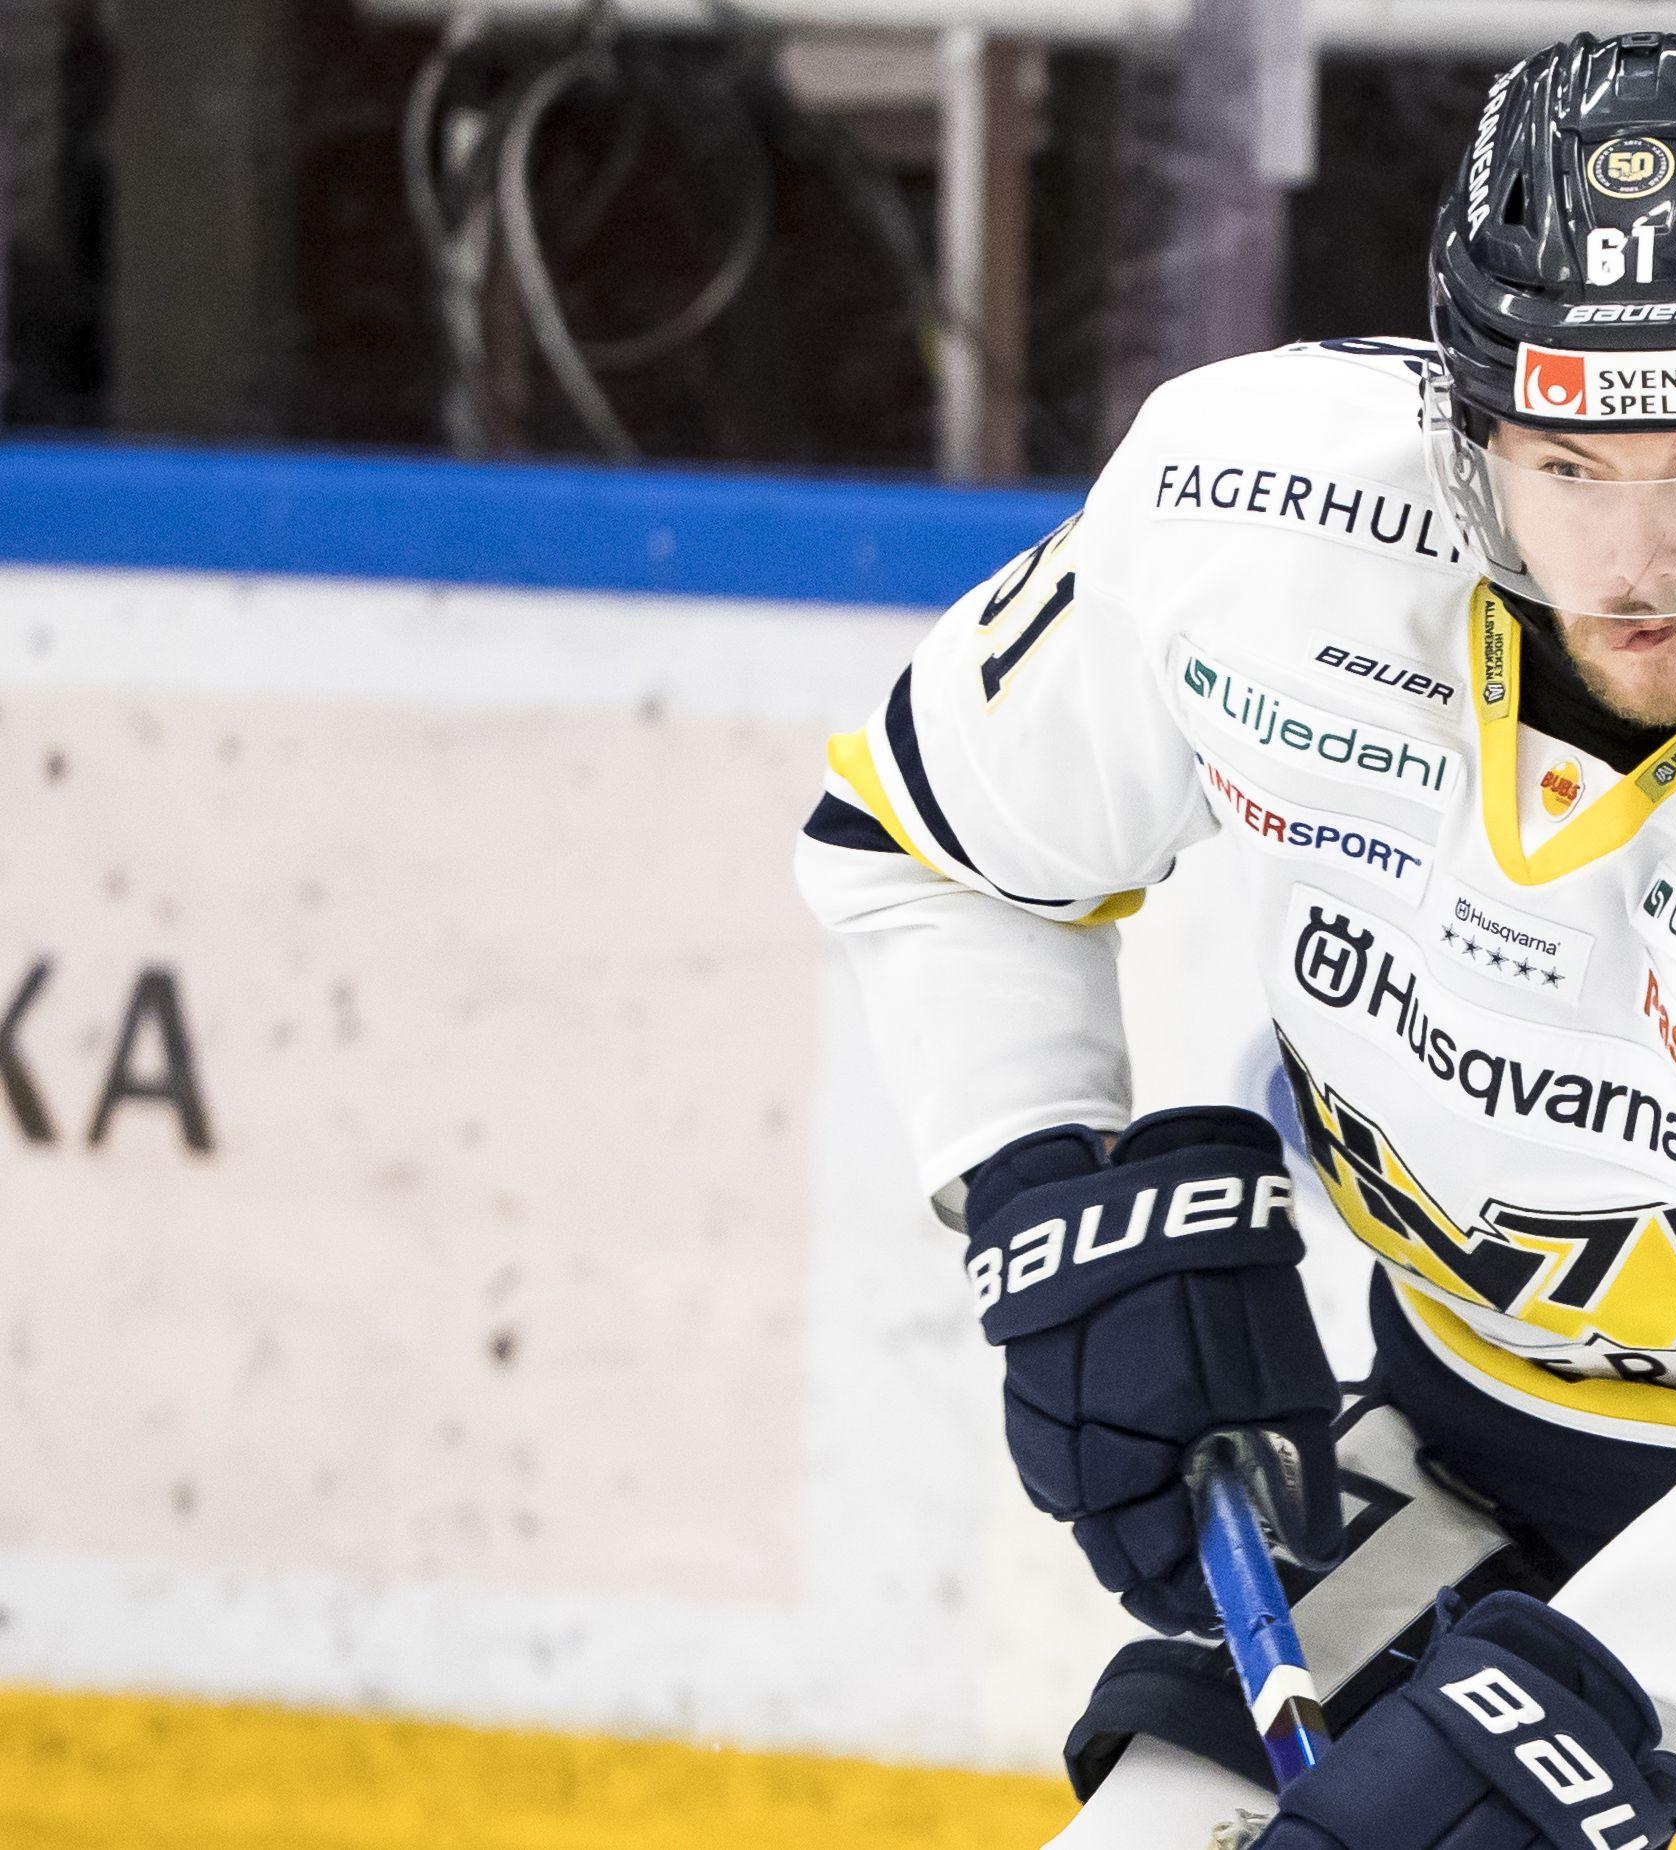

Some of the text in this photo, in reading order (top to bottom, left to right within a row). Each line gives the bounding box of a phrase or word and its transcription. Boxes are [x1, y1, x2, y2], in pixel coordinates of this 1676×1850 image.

[1608, 151, 1654, 181] 50
[1586, 227, 1656, 286] 61
[1315, 644, 1455, 706] BAUER
[1494, 633, 1504, 678] HOCKEY
[1223, 675, 1448, 791] Liljedahl
[1540, 770, 1581, 801] BUBS
[1207, 761, 1418, 879] INTERSPORT
[1470, 907, 1557, 957] Husqvarna
